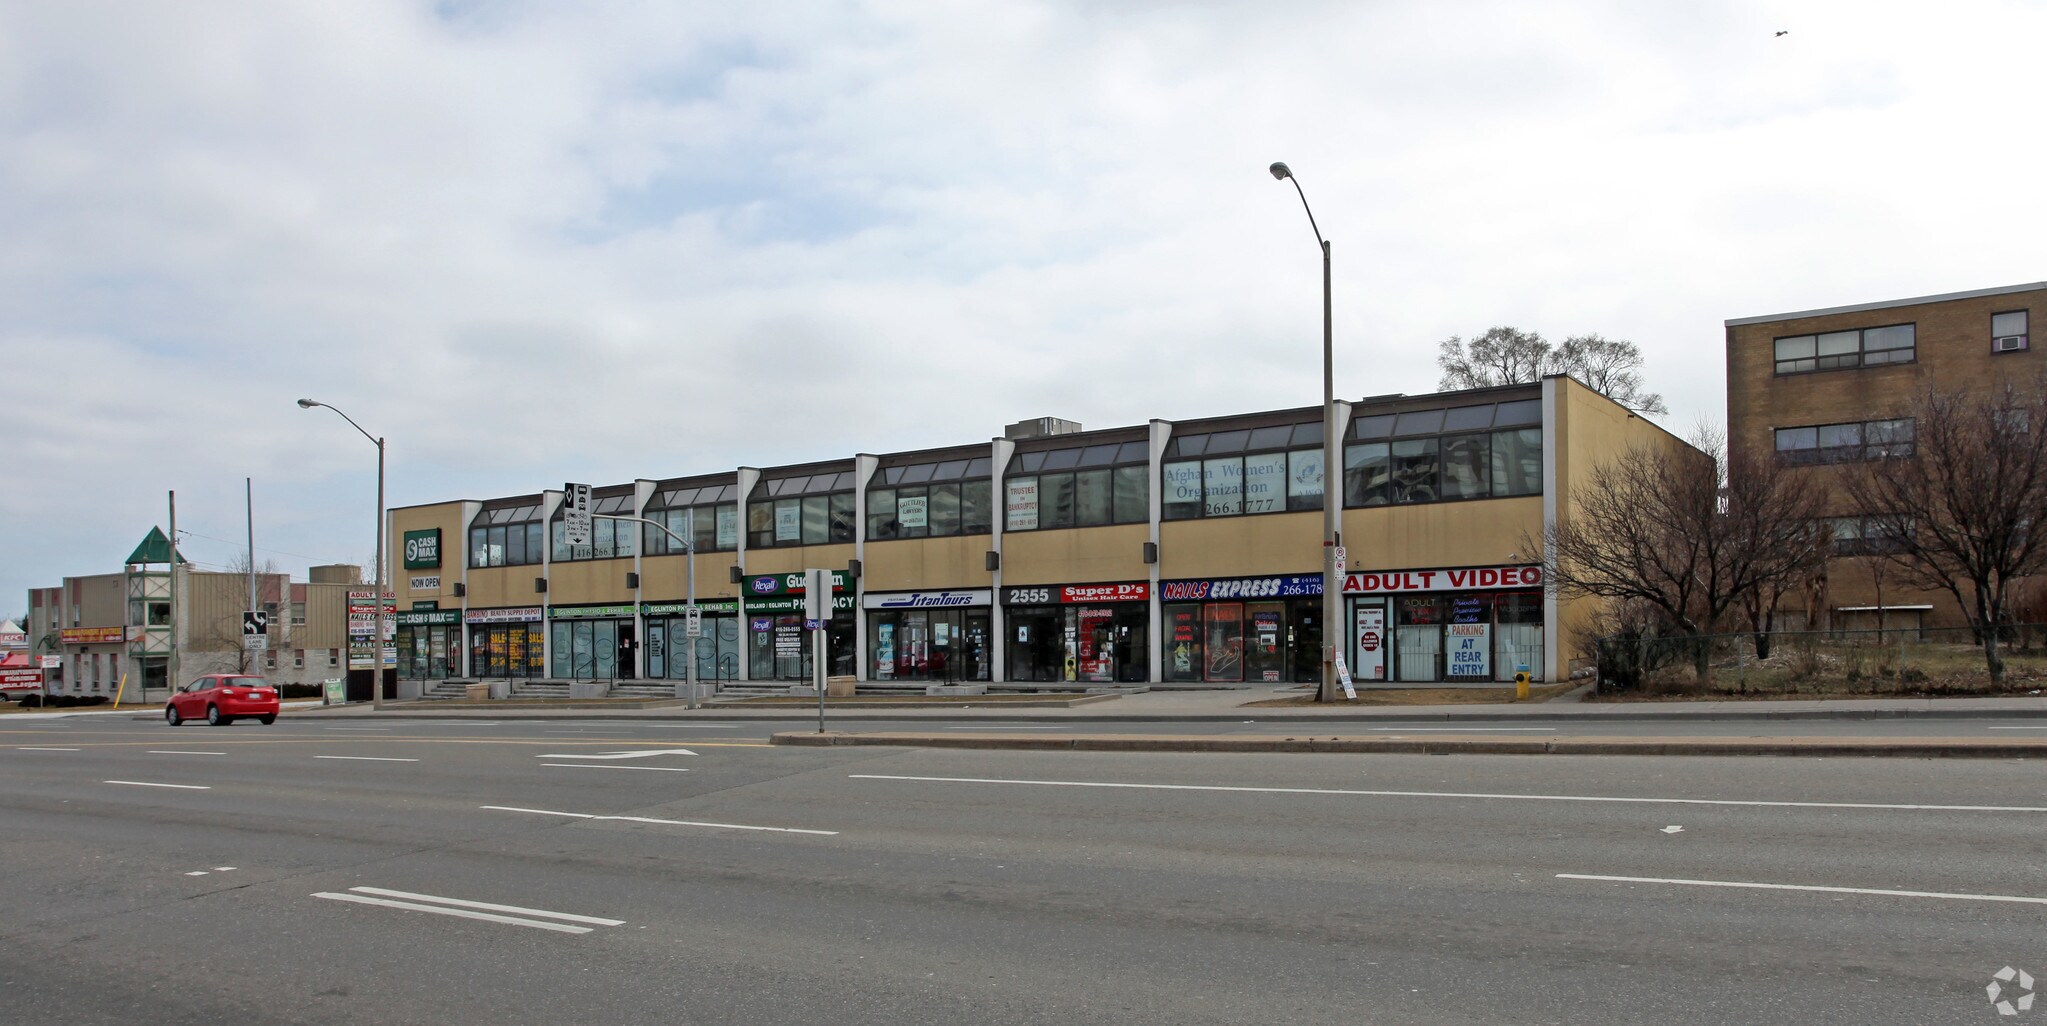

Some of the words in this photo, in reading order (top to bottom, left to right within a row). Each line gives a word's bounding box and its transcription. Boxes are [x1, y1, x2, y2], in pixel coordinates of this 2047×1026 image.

[1166, 468, 1213, 484] Afghan
[1221, 461, 1285, 478] Women's
[1010, 486, 1035, 495] TRUSTEE
[1176, 482, 1268, 501] Organization
[1008, 502, 1037, 511] BANKRUPTCY
[1206, 498, 1274, 516] 266.1777
[418, 537, 437, 547] CASH
[418, 547, 437, 557] MAX
[411, 578, 425, 588] NOW
[425, 576, 441, 587] OPEN
[1342, 571, 1437, 591] ADULT
[1446, 567, 1542, 588] VIDEO
[755, 579, 776, 592] Rexall
[1065, 586, 1113, 596] Super
[1118, 584, 1144, 594] D's
[1164, 582, 1209, 599] NAILS
[1210, 578, 1282, 598] EXPRESS
[1283, 584, 1323, 595] 266-178
[1010, 588, 1049, 603] 2555
[525, 607, 541, 615] DEPOT
[651, 604, 677, 613] EGLINTON
[351, 613, 369, 621] NAILS
[406, 614, 423, 624] CASH
[429, 612, 446, 622] MAX
[1452, 624, 1484, 636] PARKING
[491, 633, 506, 644] SALE
[529, 632, 544, 643] SALE
[1461, 638, 1475, 650] AT
[1455, 651, 1482, 663] REAR
[1452, 664, 1484, 675] ENTRY
